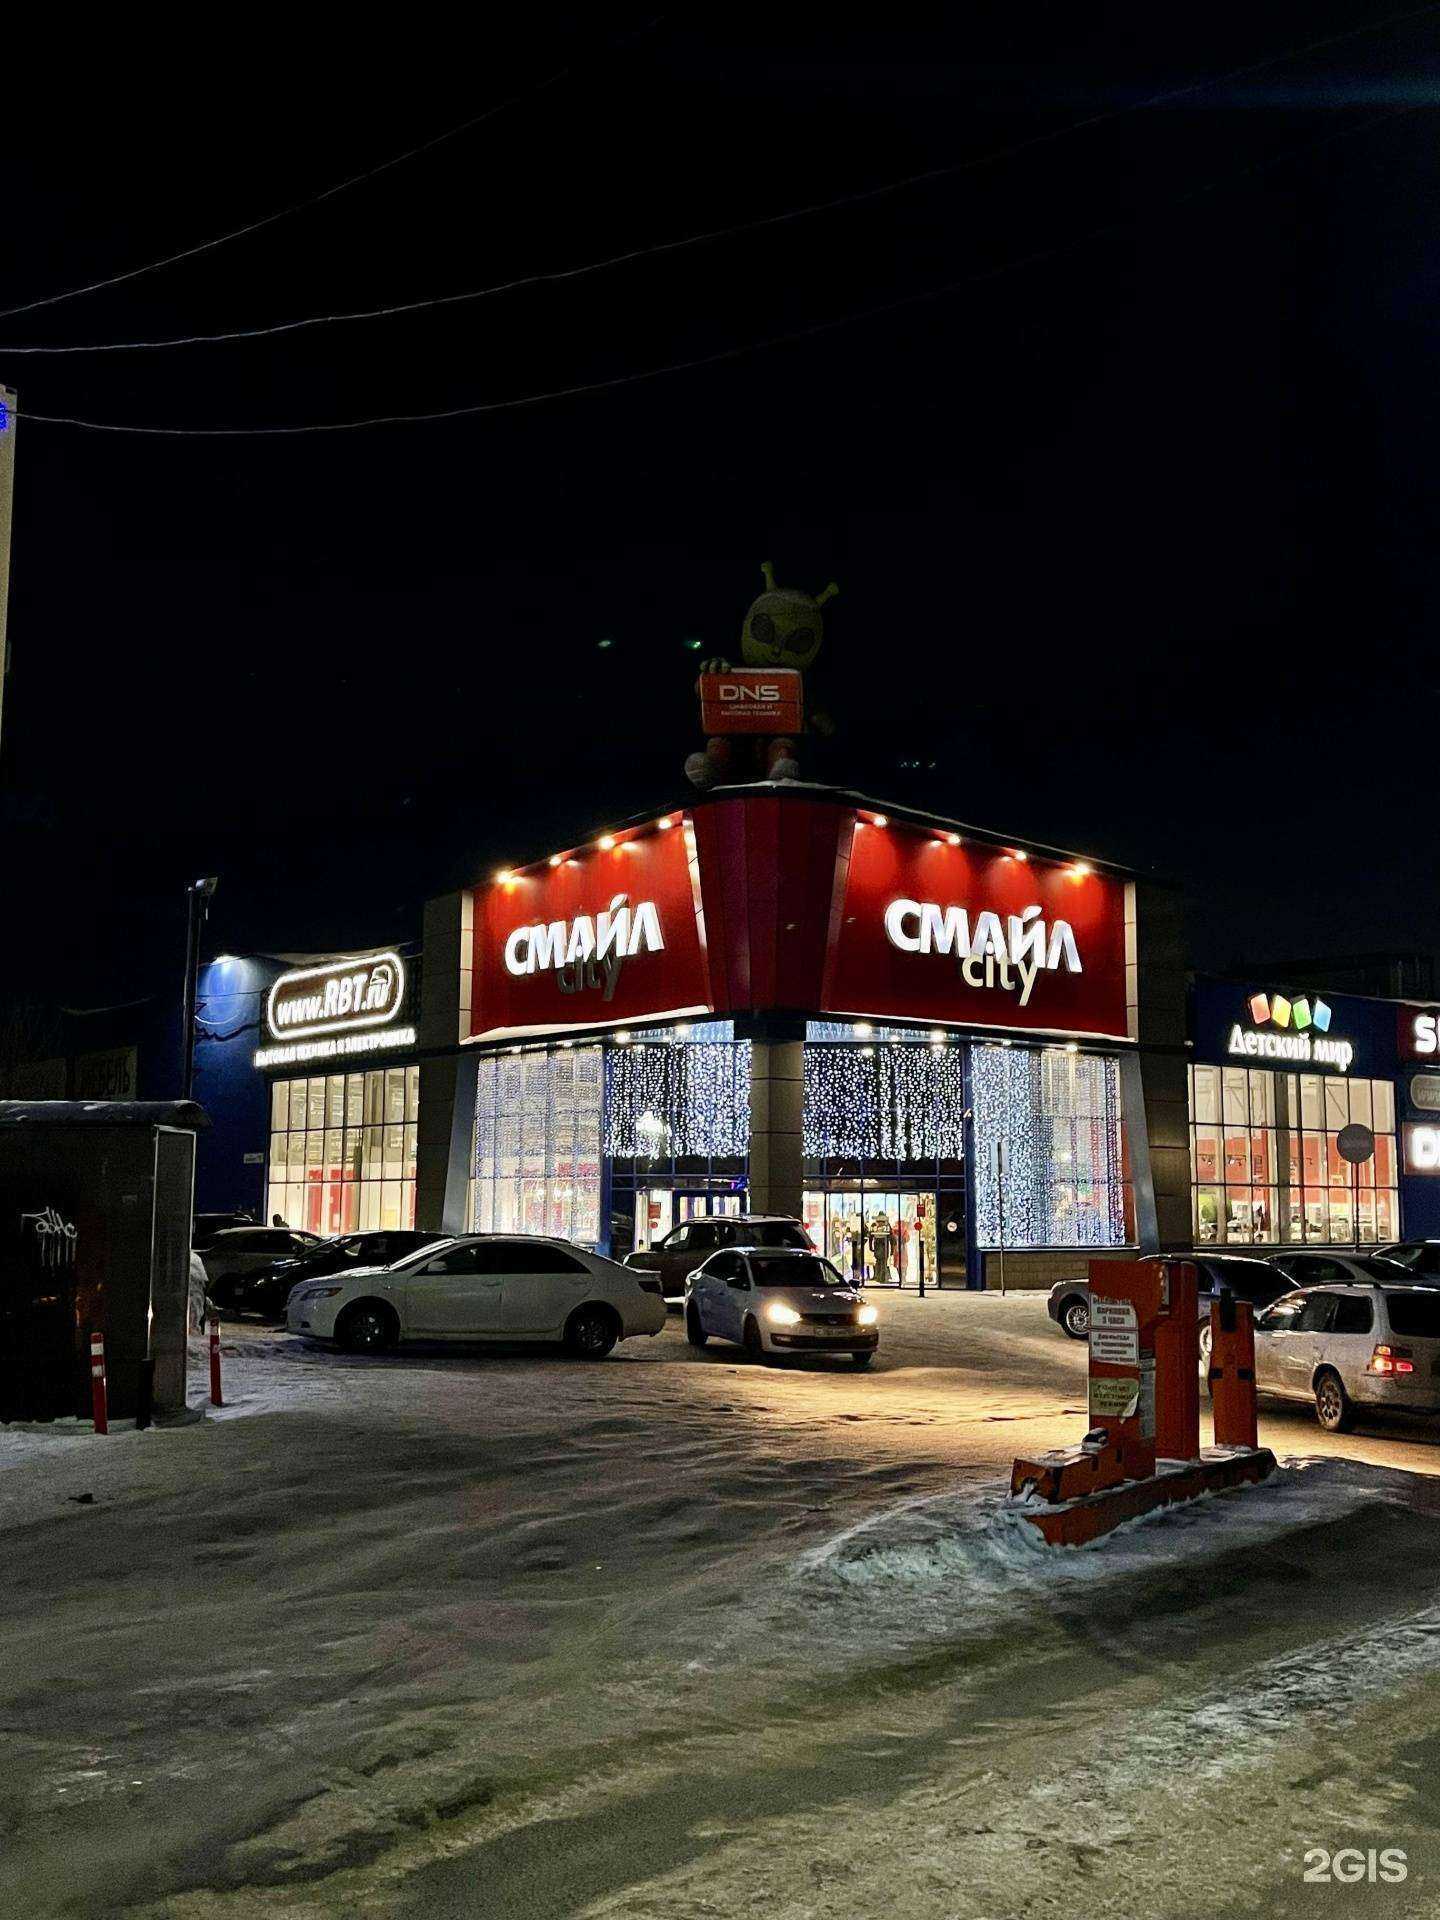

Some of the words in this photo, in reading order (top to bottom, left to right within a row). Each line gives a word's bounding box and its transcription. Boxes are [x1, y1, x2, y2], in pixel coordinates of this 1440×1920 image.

[719, 684, 780, 700] DNS
[505, 893, 665, 975] СМАЙЛ
[885, 899, 1083, 973] СМАЙЛ
[558, 945, 621, 1001] city
[962, 941, 1038, 1006] city
[1228, 1024, 1311, 1061] Детский
[1313, 1039, 1353, 1072] мир
